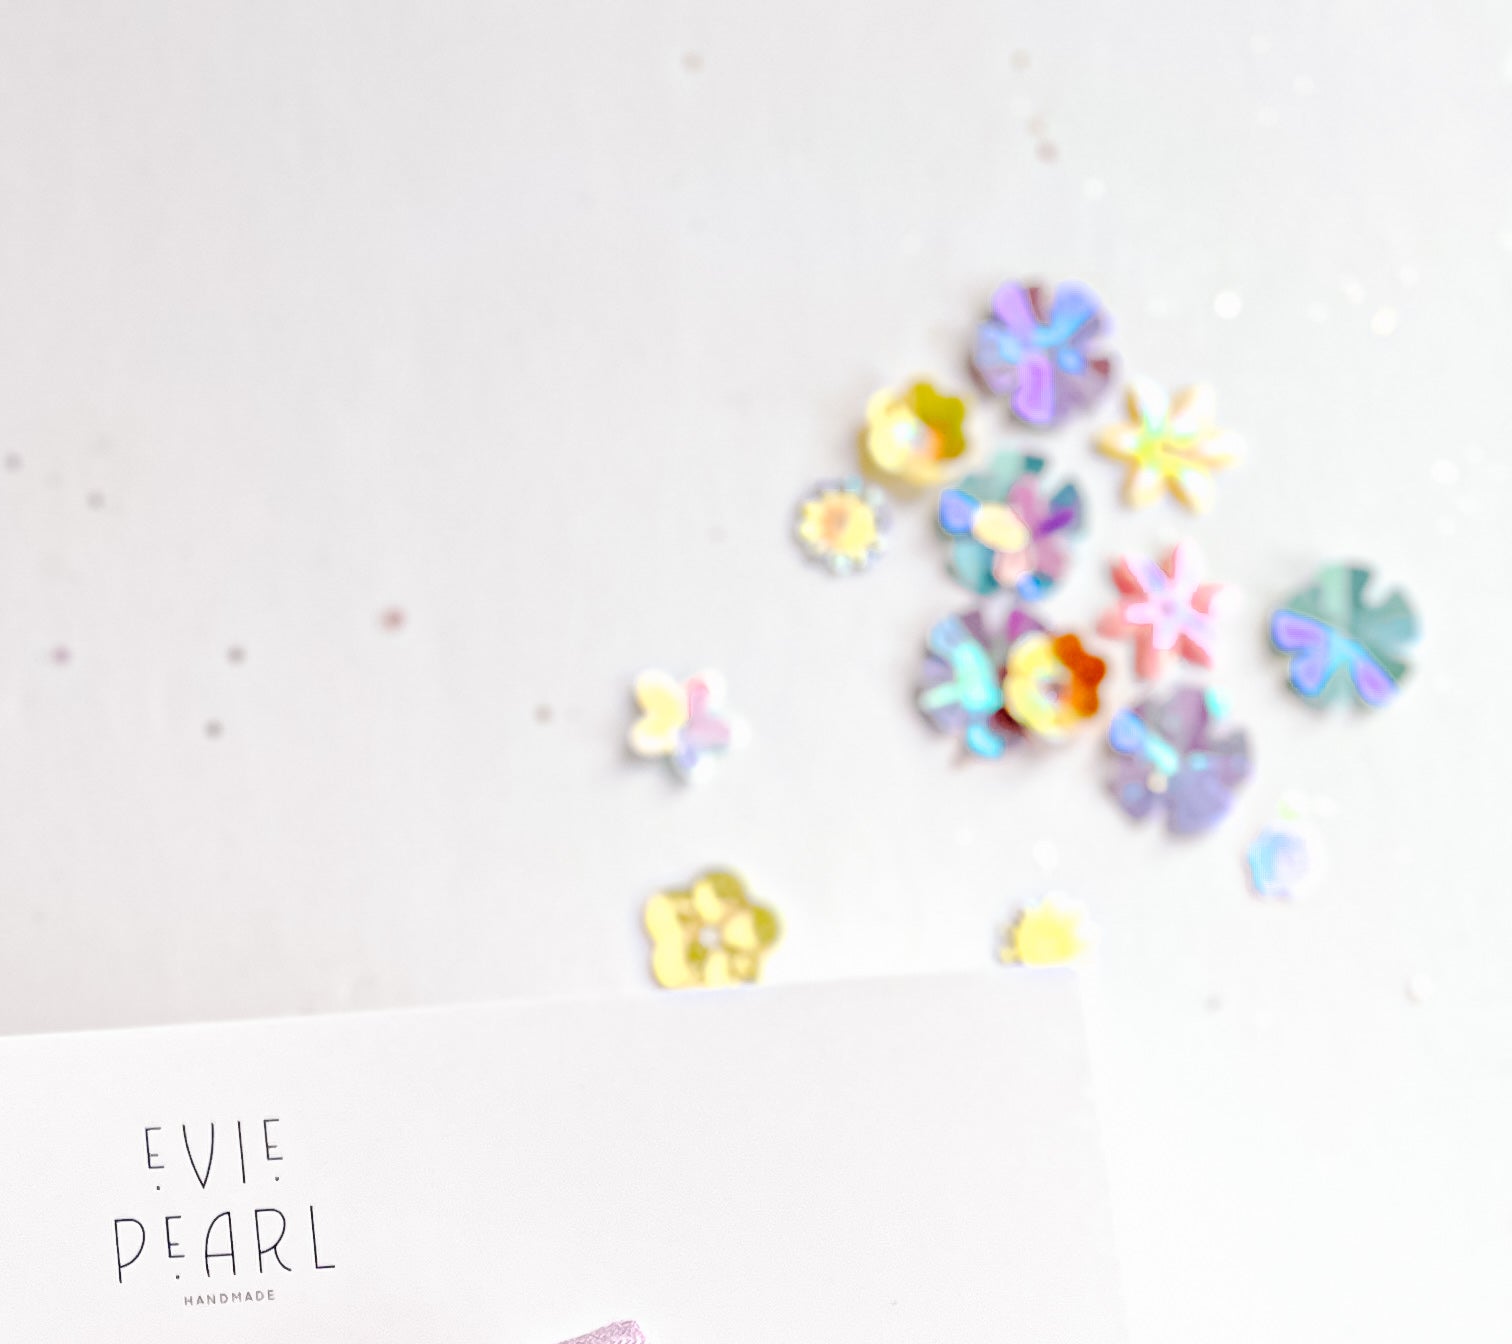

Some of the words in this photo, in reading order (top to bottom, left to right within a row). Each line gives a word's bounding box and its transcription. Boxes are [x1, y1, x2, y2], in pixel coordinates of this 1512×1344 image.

[144, 1118, 283, 1190] EVIE
[113, 1205, 336, 1284] PEARL
[184, 1289, 276, 1306] HANDMADE
